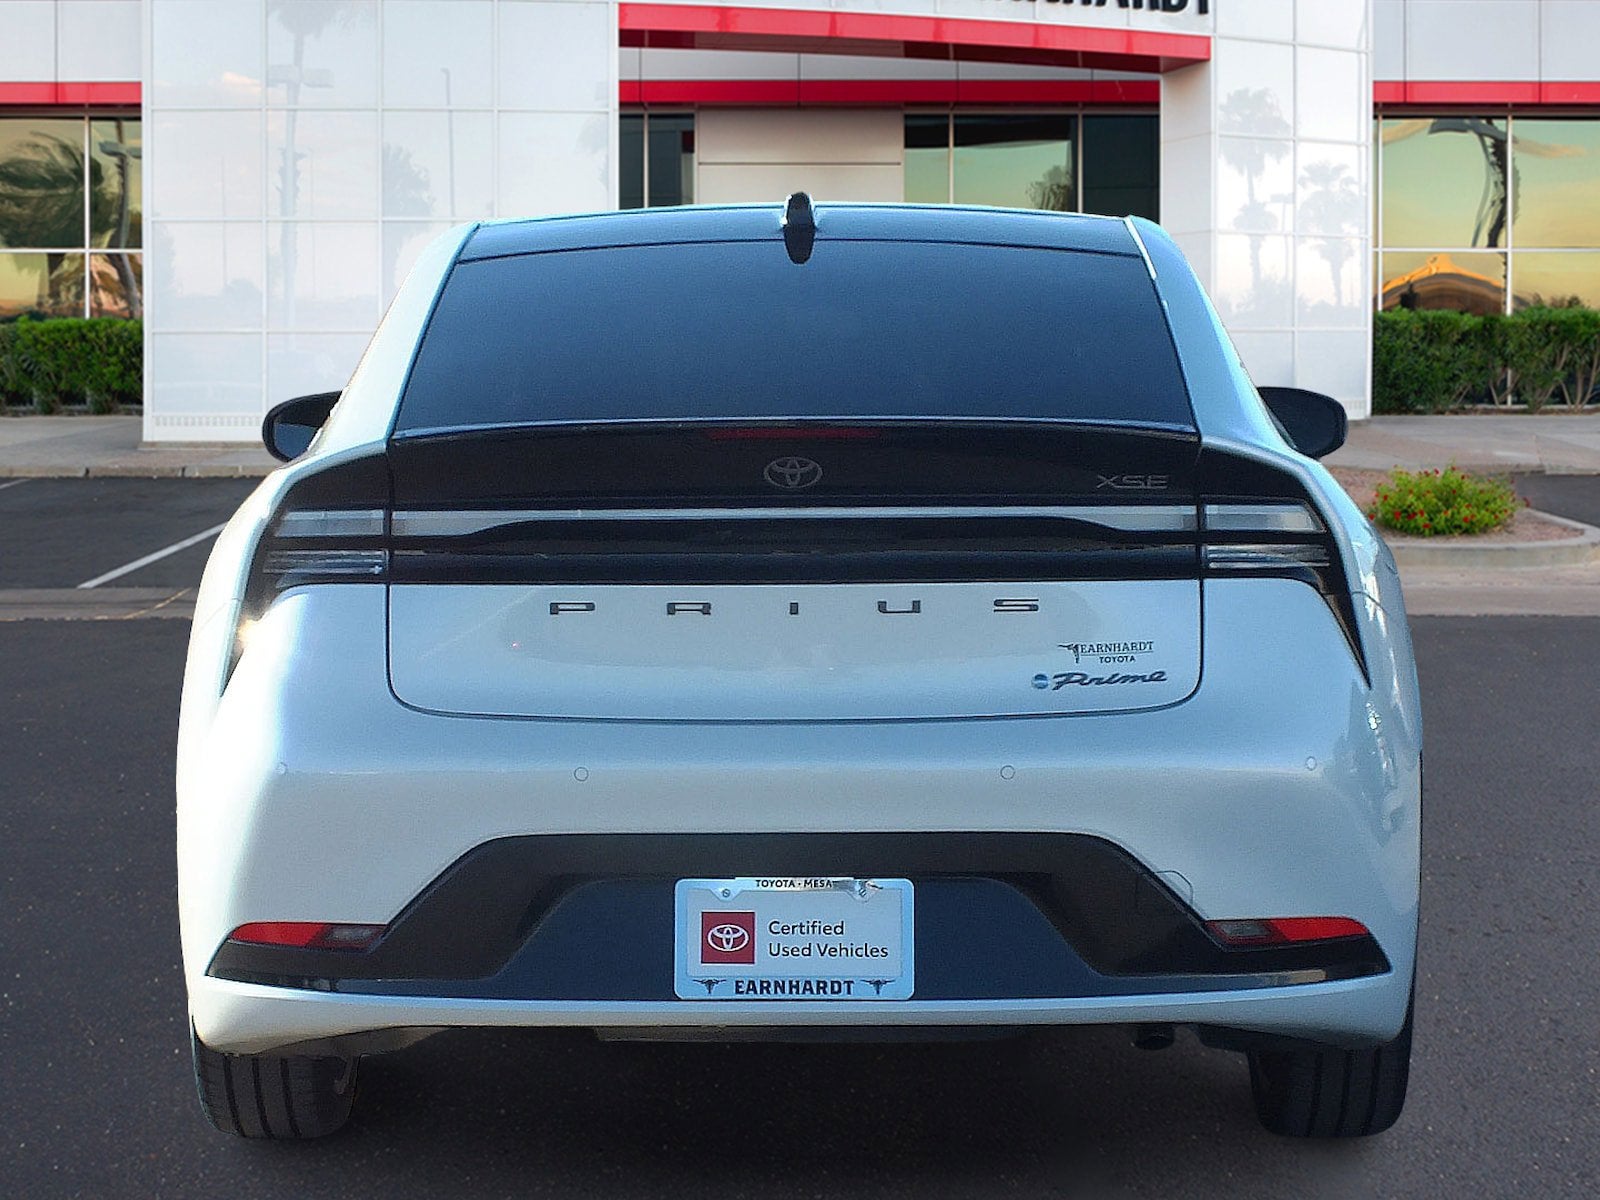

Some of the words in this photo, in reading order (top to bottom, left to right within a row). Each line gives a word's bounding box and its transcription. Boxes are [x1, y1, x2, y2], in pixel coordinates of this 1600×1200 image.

[1096, 475, 1169, 489] XSE
[550, 598, 1039, 615] PRIUS
[1080, 641, 1154, 653] EARNHARDT
[1099, 655, 1136, 664] TOYOTA
[1052, 671, 1167, 690] Prime
[755, 879, 796, 888] TOYOTA
[768, 920, 844, 936] Certified
[768, 943, 812, 957] Used
[816, 943, 889, 957] Vehicles
[734, 979, 855, 995] EARNHARDT
